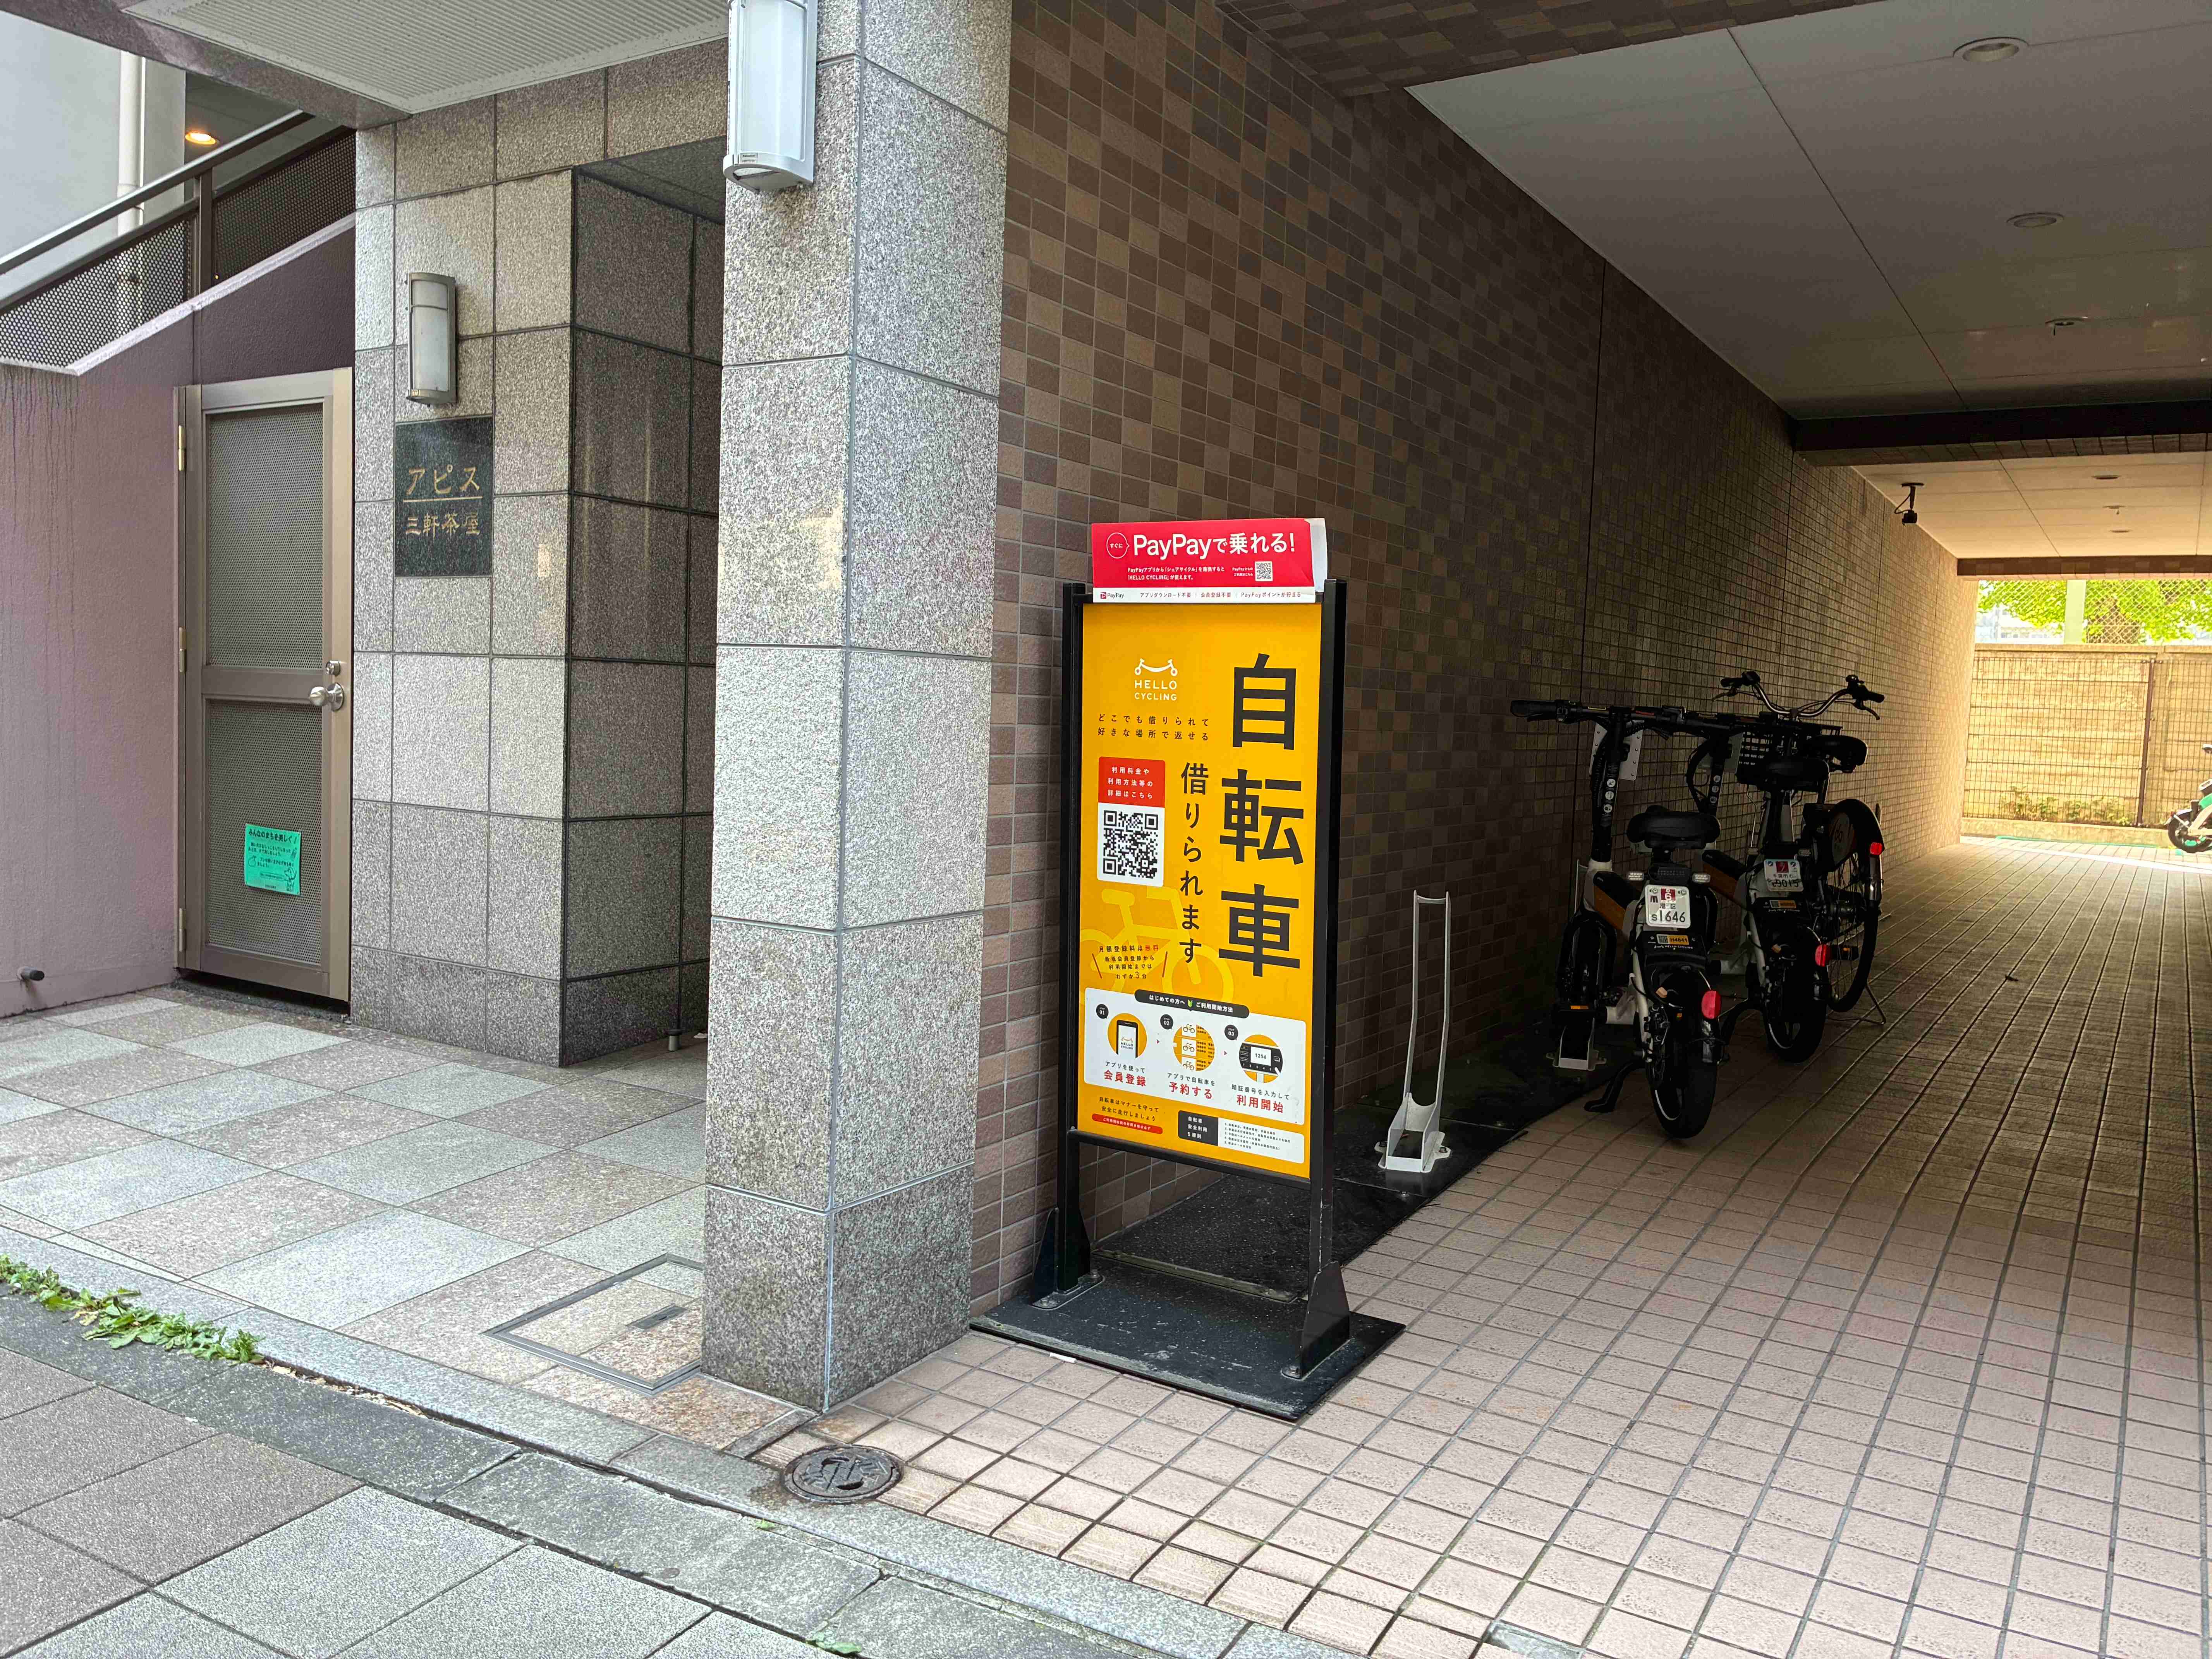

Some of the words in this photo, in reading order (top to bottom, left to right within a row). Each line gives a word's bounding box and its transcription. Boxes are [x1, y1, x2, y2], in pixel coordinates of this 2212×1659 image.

[405, 464, 480, 496] アピス
[405, 512, 480, 537] 三軒茶屋
[1133, 532, 1295, 560] PayPayで乗れる!
[1134, 680, 1177, 690] HELLO
[1134, 692, 1177, 701] CYCLING
[1099, 714, 1209, 726] どこでも借りられて
[1098, 728, 1208, 741] 好きな場所で返せる
[1112, 766, 1149, 775] 利用料金や
[1108, 778, 1153, 787] 利用方法等の
[1108, 790, 1152, 799] 詳細はこちら
[1218, 653, 1304, 977] 自転車
[1179, 762, 1209, 963] 借りられます
[1149, 994, 1185, 1004] はじめての方へ
[1196, 1002, 1233, 1013] ご利用開始方法
[1106, 1061, 1145, 1073] アプリを使って
[1104, 1070, 1146, 1087] 会員登録
[1167, 1073, 1215, 1086] アプリで自転車を
[1169, 1082, 1212, 1099] 予約する
[1231, 1084, 1289, 1100] 暗証番号を入力して
[1099, 1096, 1159, 1113] 自転車はマナーを守って
[1237, 1094, 1283, 1113] 利用開始
[1102, 1106, 1155, 1121] 安全に走行しましょう
[1188, 1124, 1207, 1132] 安全利用
